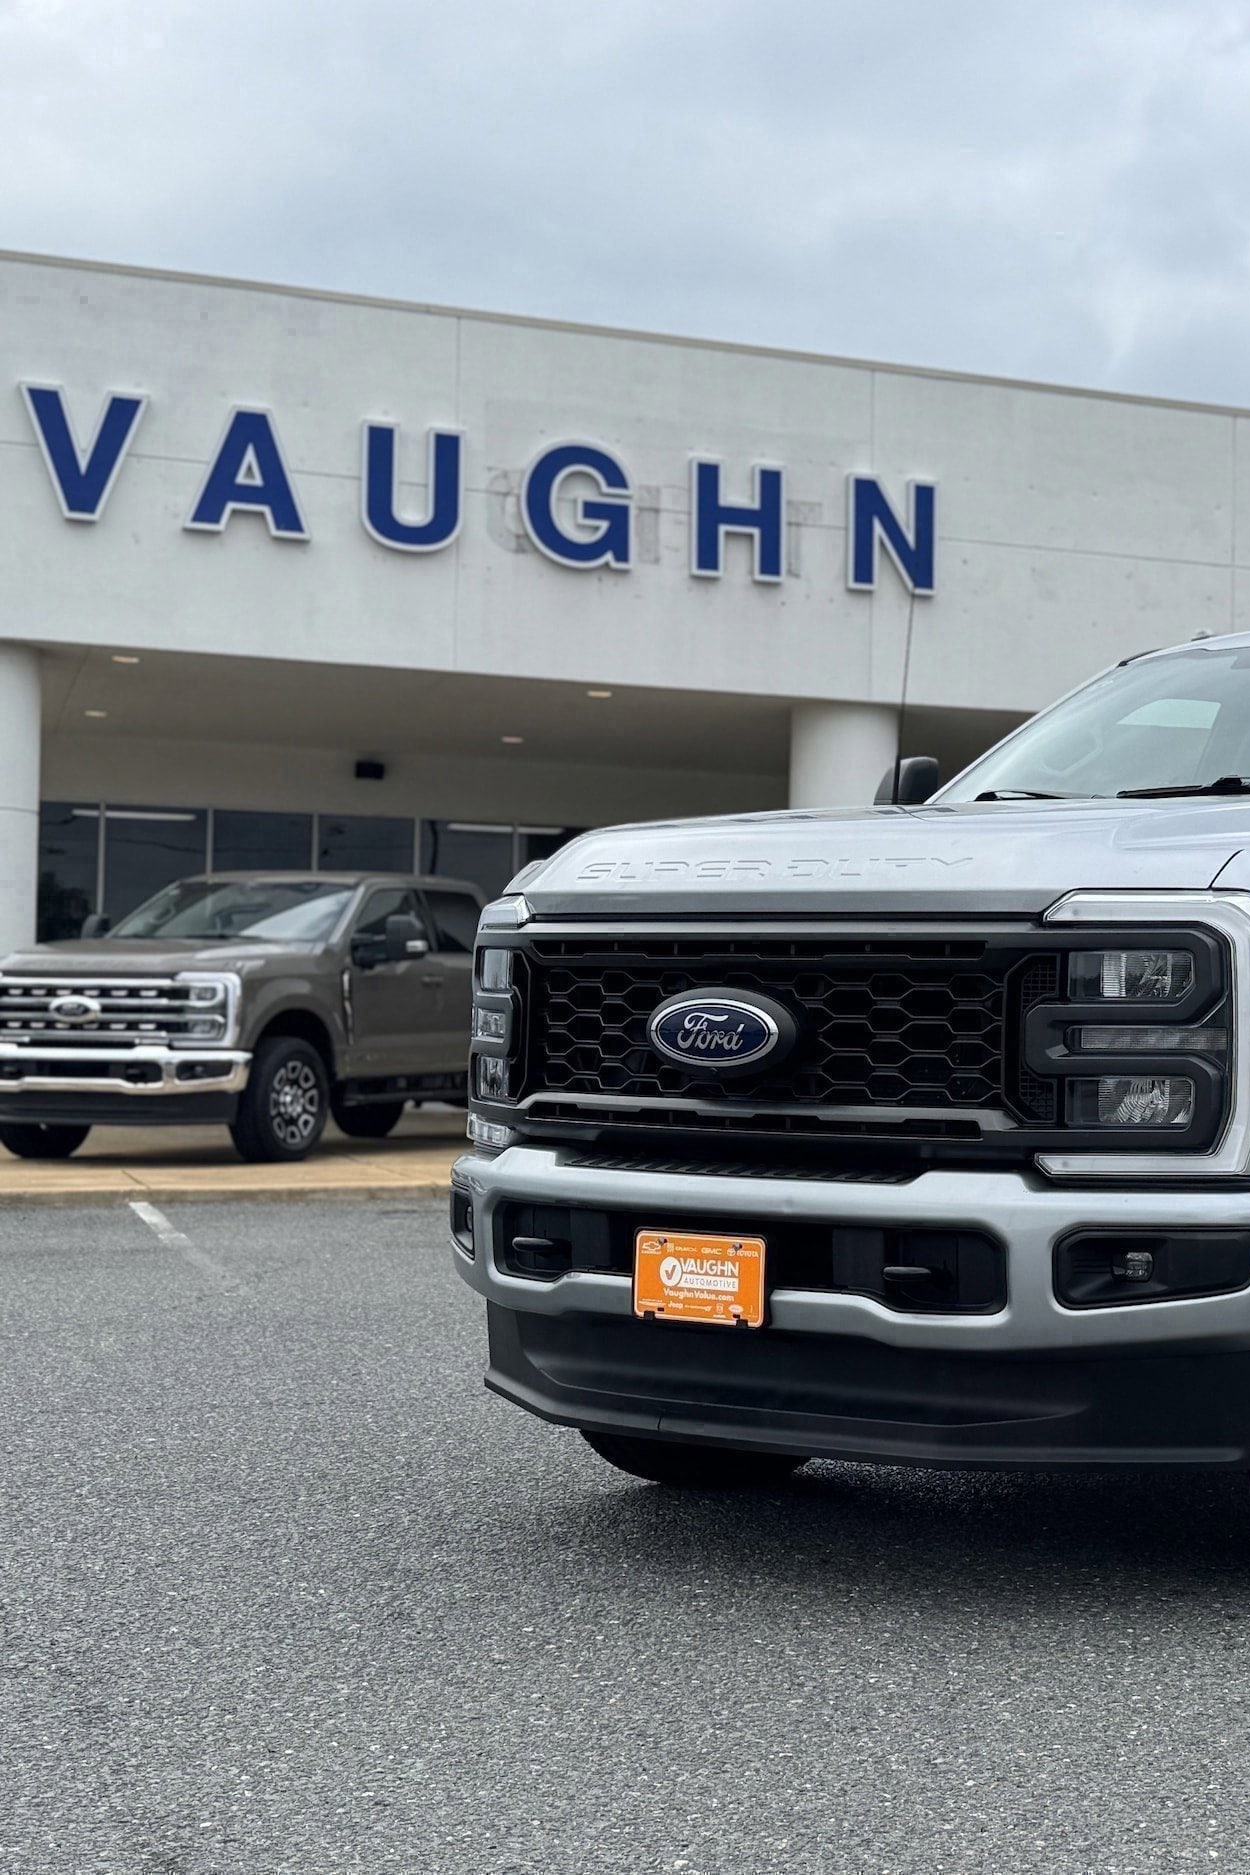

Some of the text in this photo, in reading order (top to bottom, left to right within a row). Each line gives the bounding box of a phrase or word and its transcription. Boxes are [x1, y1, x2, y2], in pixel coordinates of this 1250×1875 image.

[19, 381, 938, 598] VAUGHN
[576, 857, 974, 882] SUPER DUTY
[677, 1012, 745, 1050] Ford
[701, 1247, 722, 1255] GMC
[680, 1258, 739, 1276] VAUGHN
[684, 1277, 736, 1288] AUTOMOTIVE
[668, 1301, 683, 1309] Jeep
